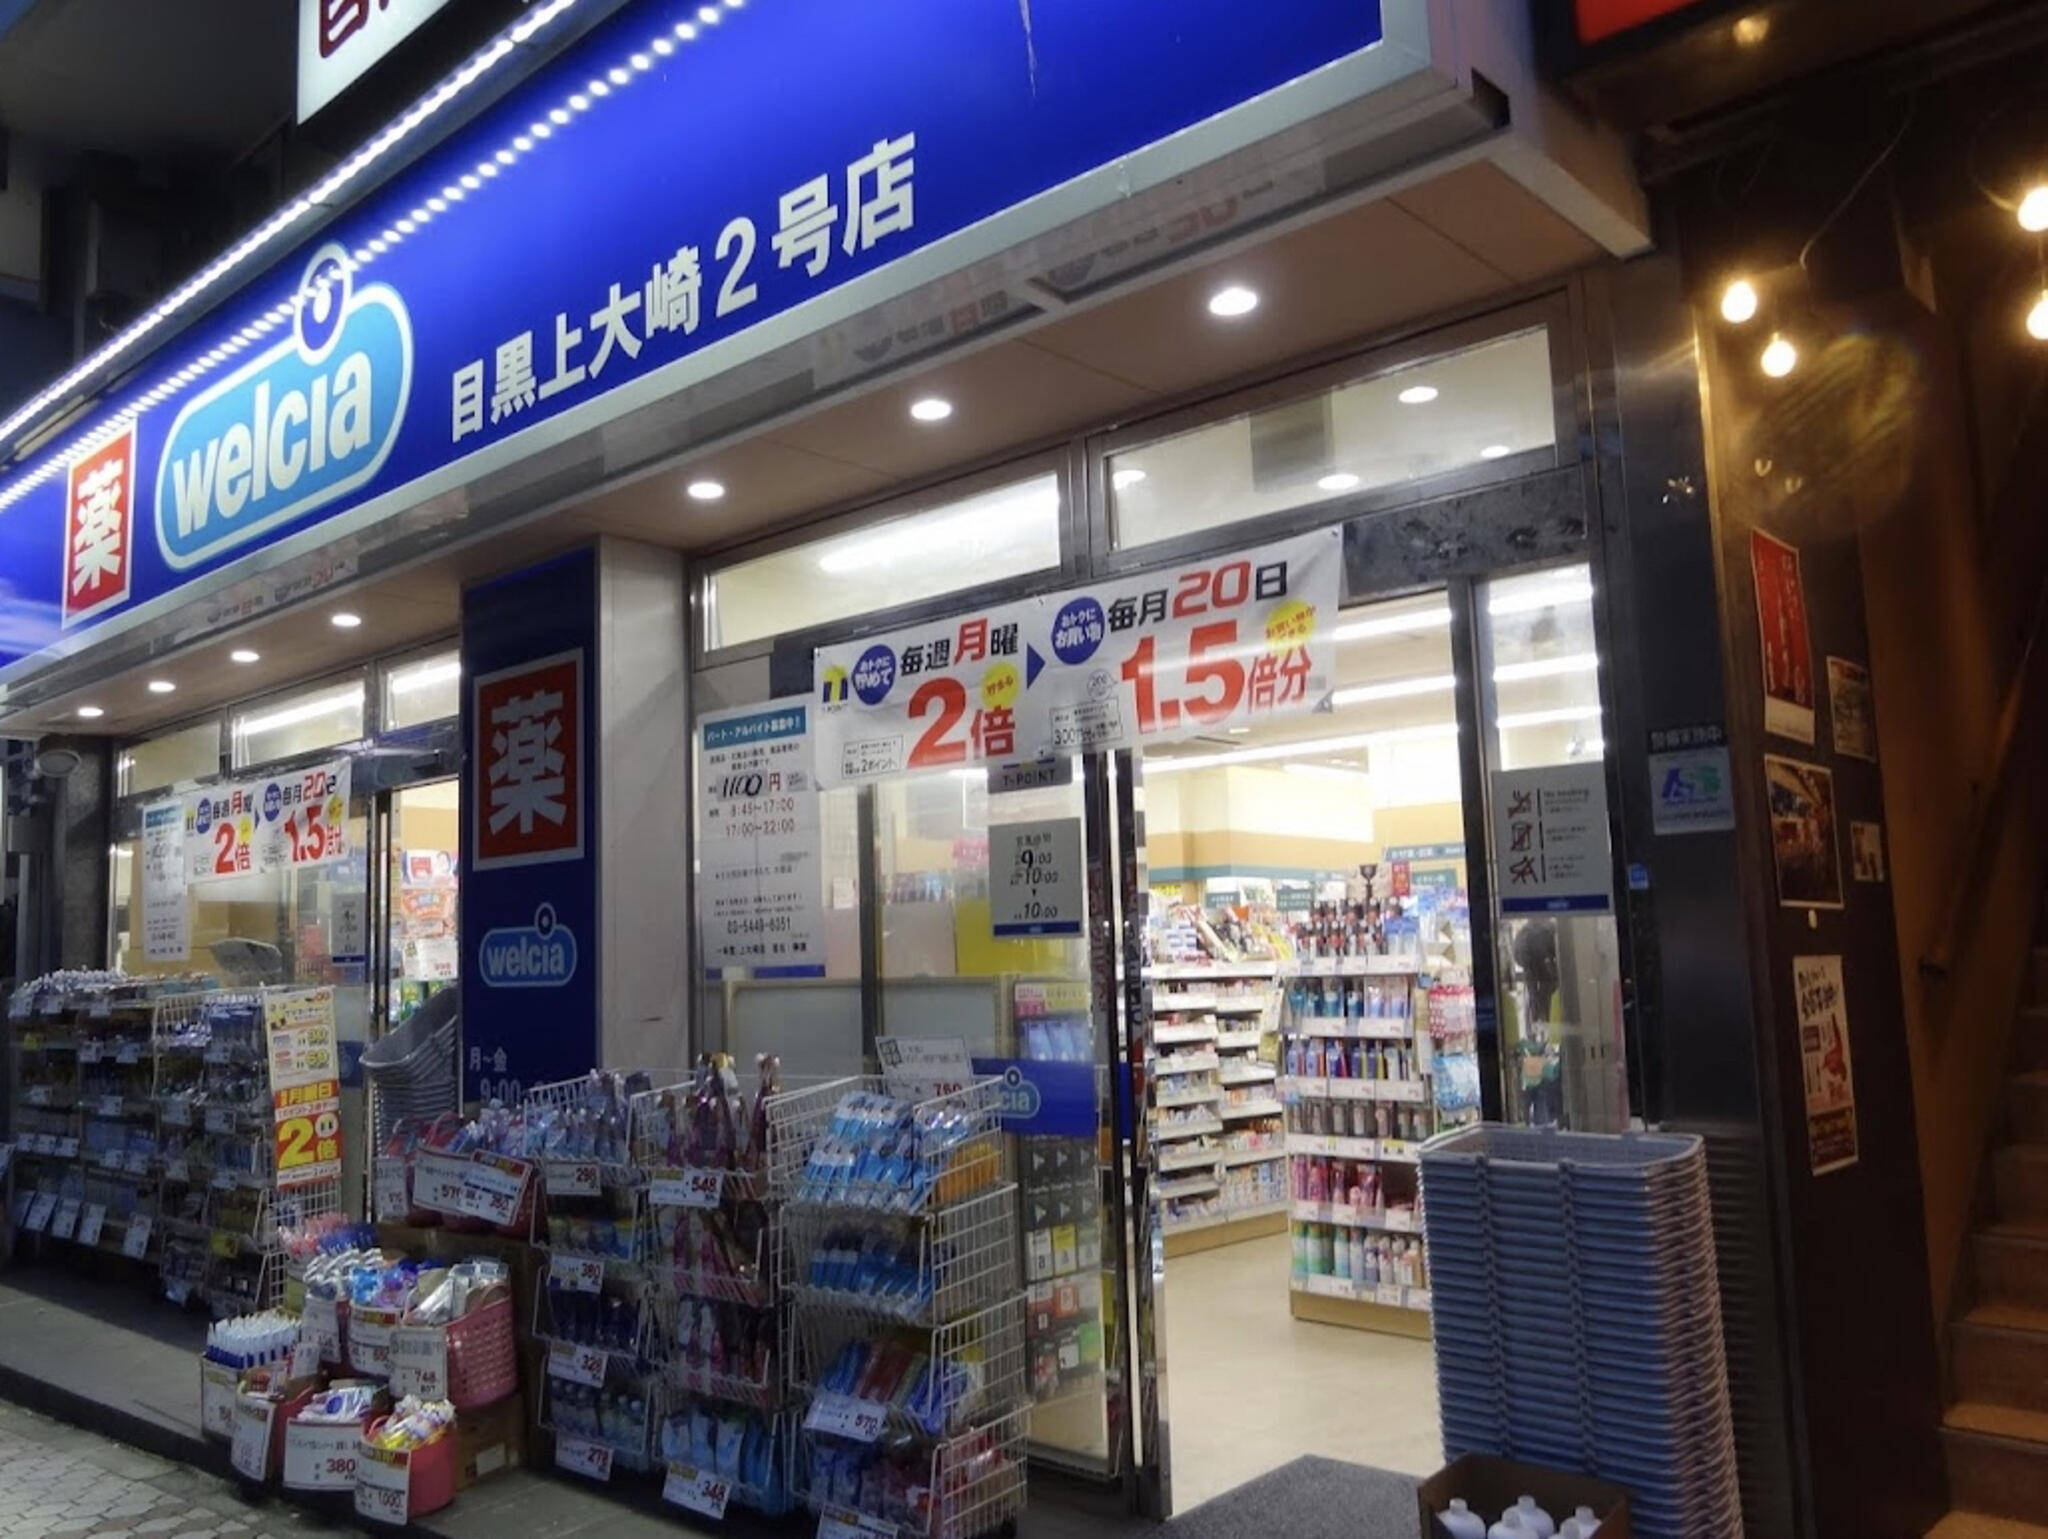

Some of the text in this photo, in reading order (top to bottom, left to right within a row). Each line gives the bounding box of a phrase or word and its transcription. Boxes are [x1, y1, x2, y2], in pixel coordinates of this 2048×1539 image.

[451, 132, 916, 443] 目黒上大崎2号店
[172, 350, 372, 538] welcia
[72, 459, 122, 591] 薬
[1108, 561, 1288, 631] 毎月20日
[900, 618, 1019, 677] 毎週月曜
[1121, 620, 1312, 734] 1.5倍分
[488, 690, 567, 836] 薬
[906, 677, 1016, 769] 2倍
[769, 772, 781, 792] 円
[486, 943, 565, 978] welcia
[278, 1117, 338, 1170] 2倍
[326, 1458, 356, 1473] 380
